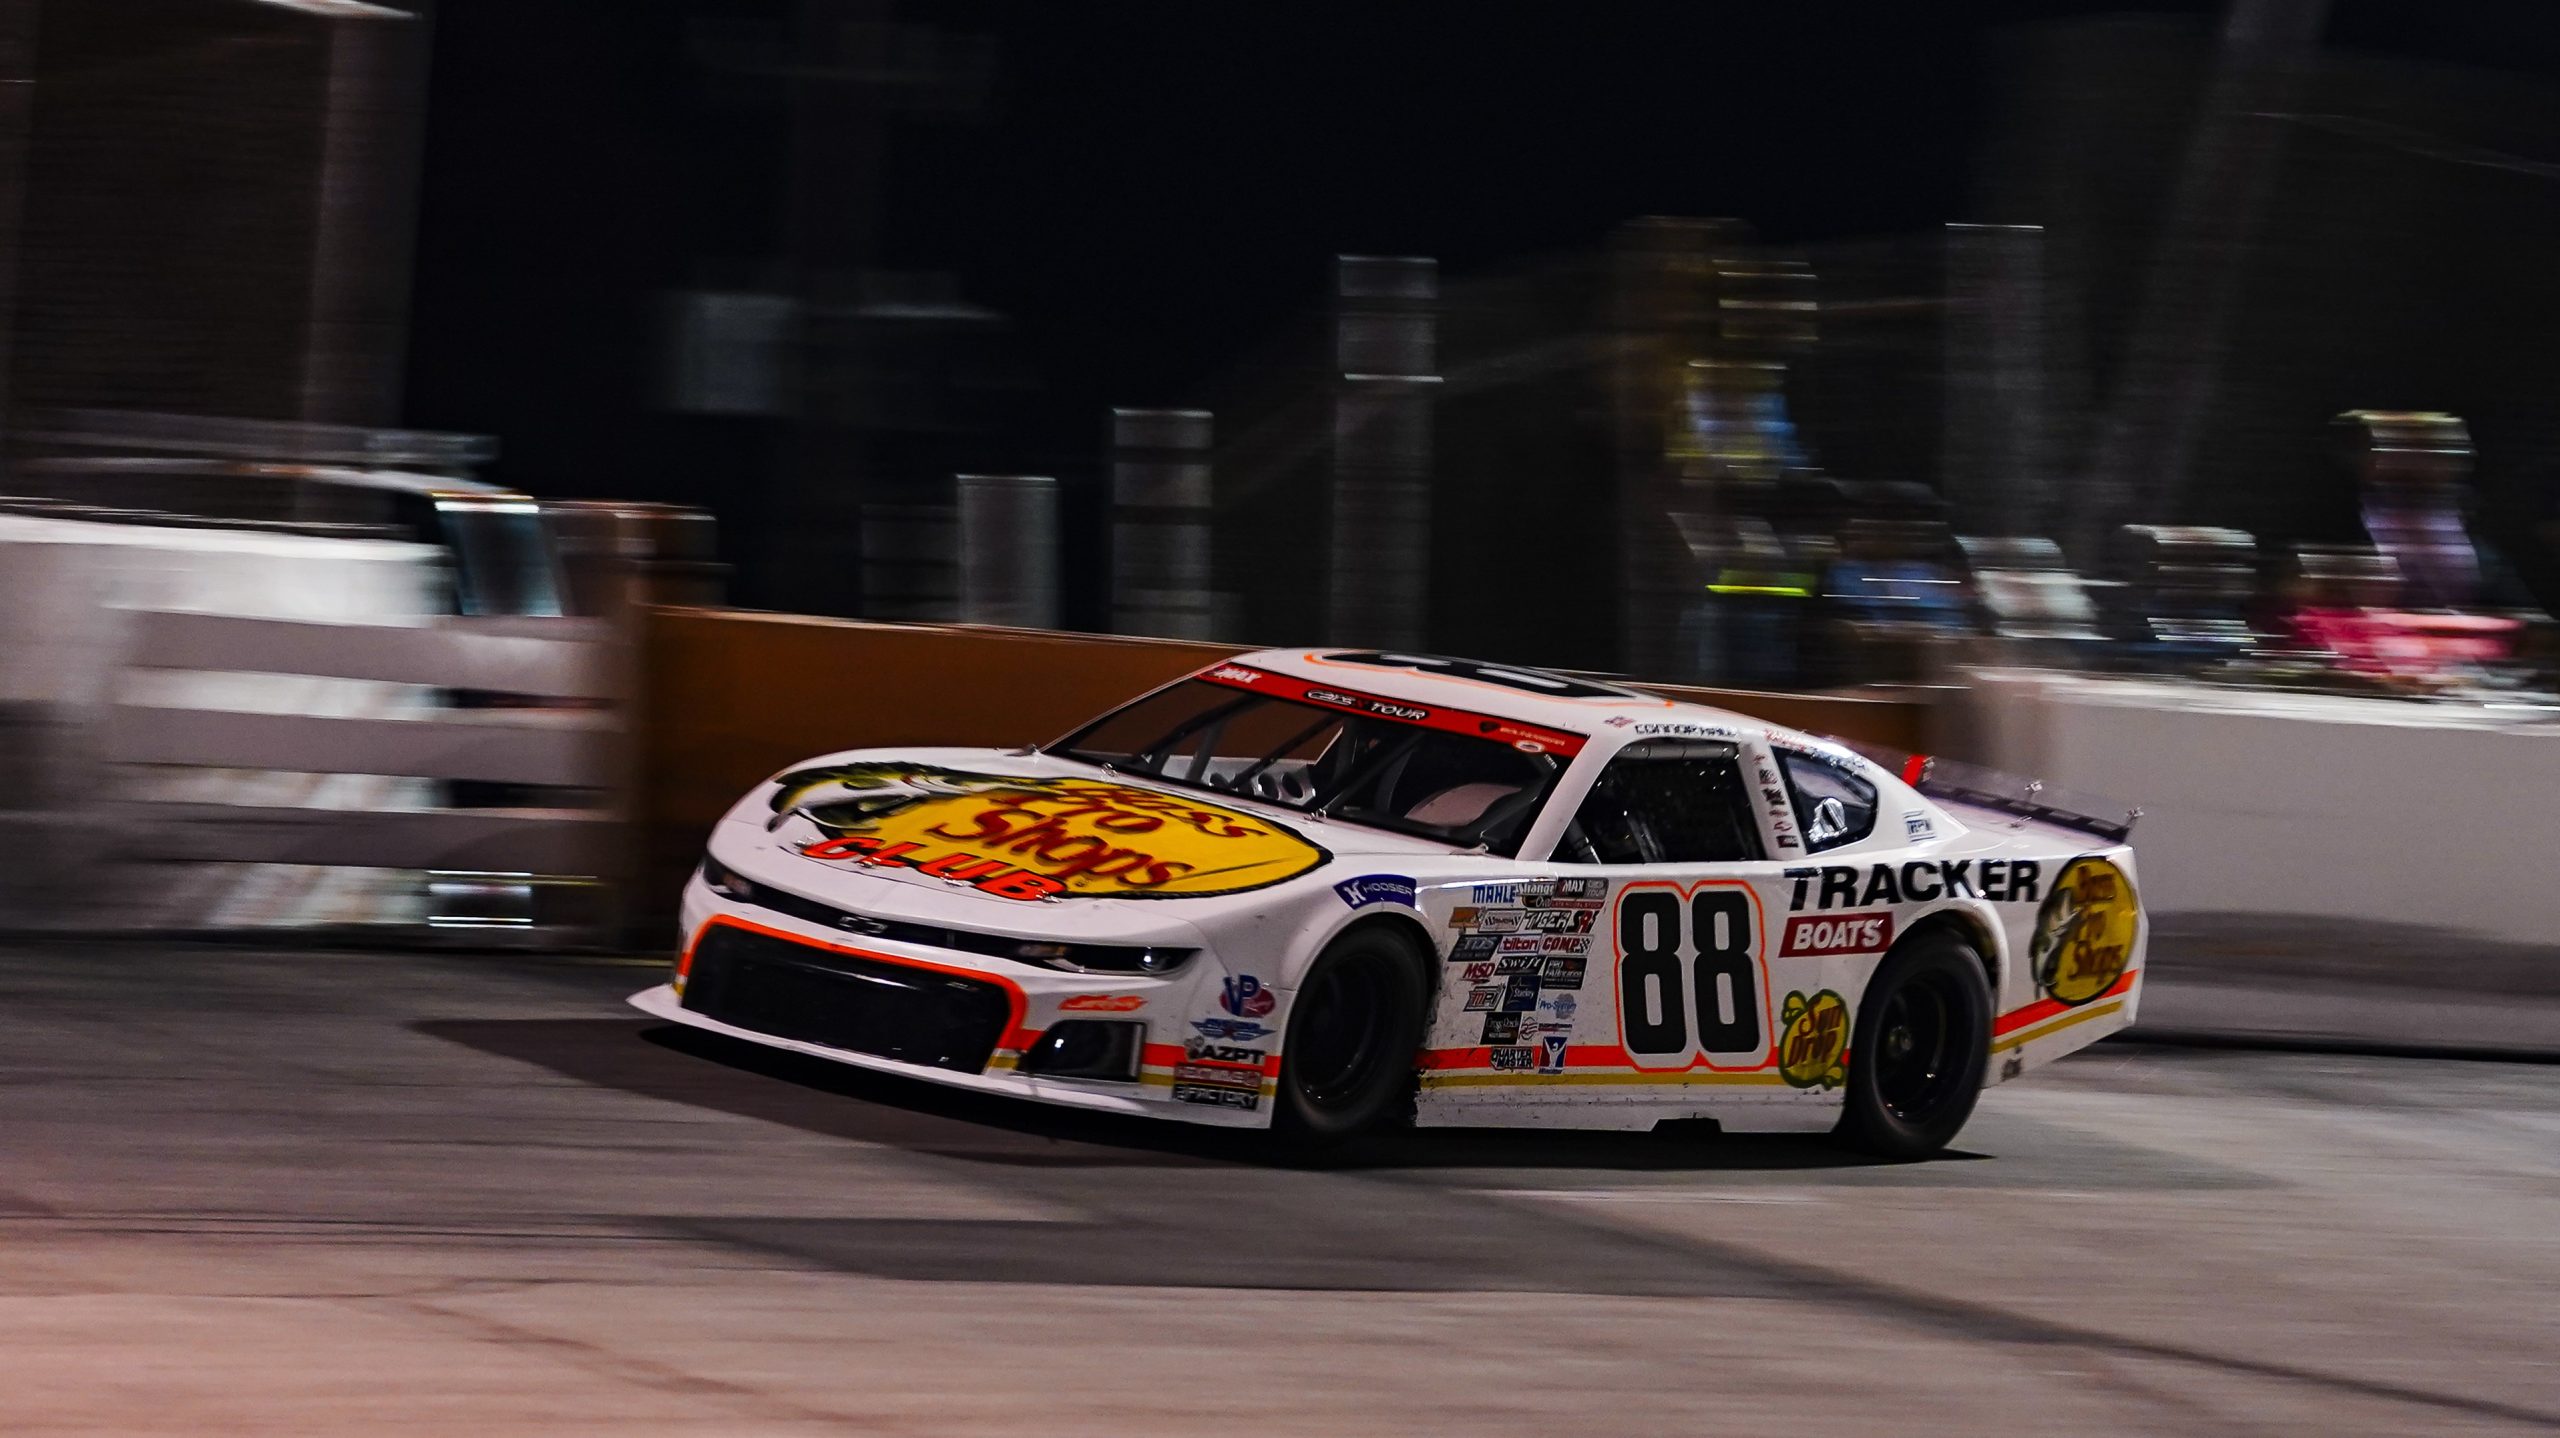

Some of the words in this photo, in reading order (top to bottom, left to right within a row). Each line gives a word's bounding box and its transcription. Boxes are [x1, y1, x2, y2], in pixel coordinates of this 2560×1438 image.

[1370, 702, 1426, 720] TOUR
[927, 806, 1195, 888] Shops
[802, 836, 1068, 902] CLUB
[1363, 882, 1413, 896] HOOSIER
[1472, 885, 1516, 904] MAHLE
[1784, 859, 2041, 911] TRACKER
[1526, 911, 1572, 930] TIGER
[1503, 937, 1538, 950] tilton
[1542, 936, 1581, 952] COMP
[1793, 918, 1884, 951] BOATS
[1463, 962, 1495, 979] MSD
[1620, 890, 1760, 1055] 88
[1223, 974, 1261, 1017] VP
